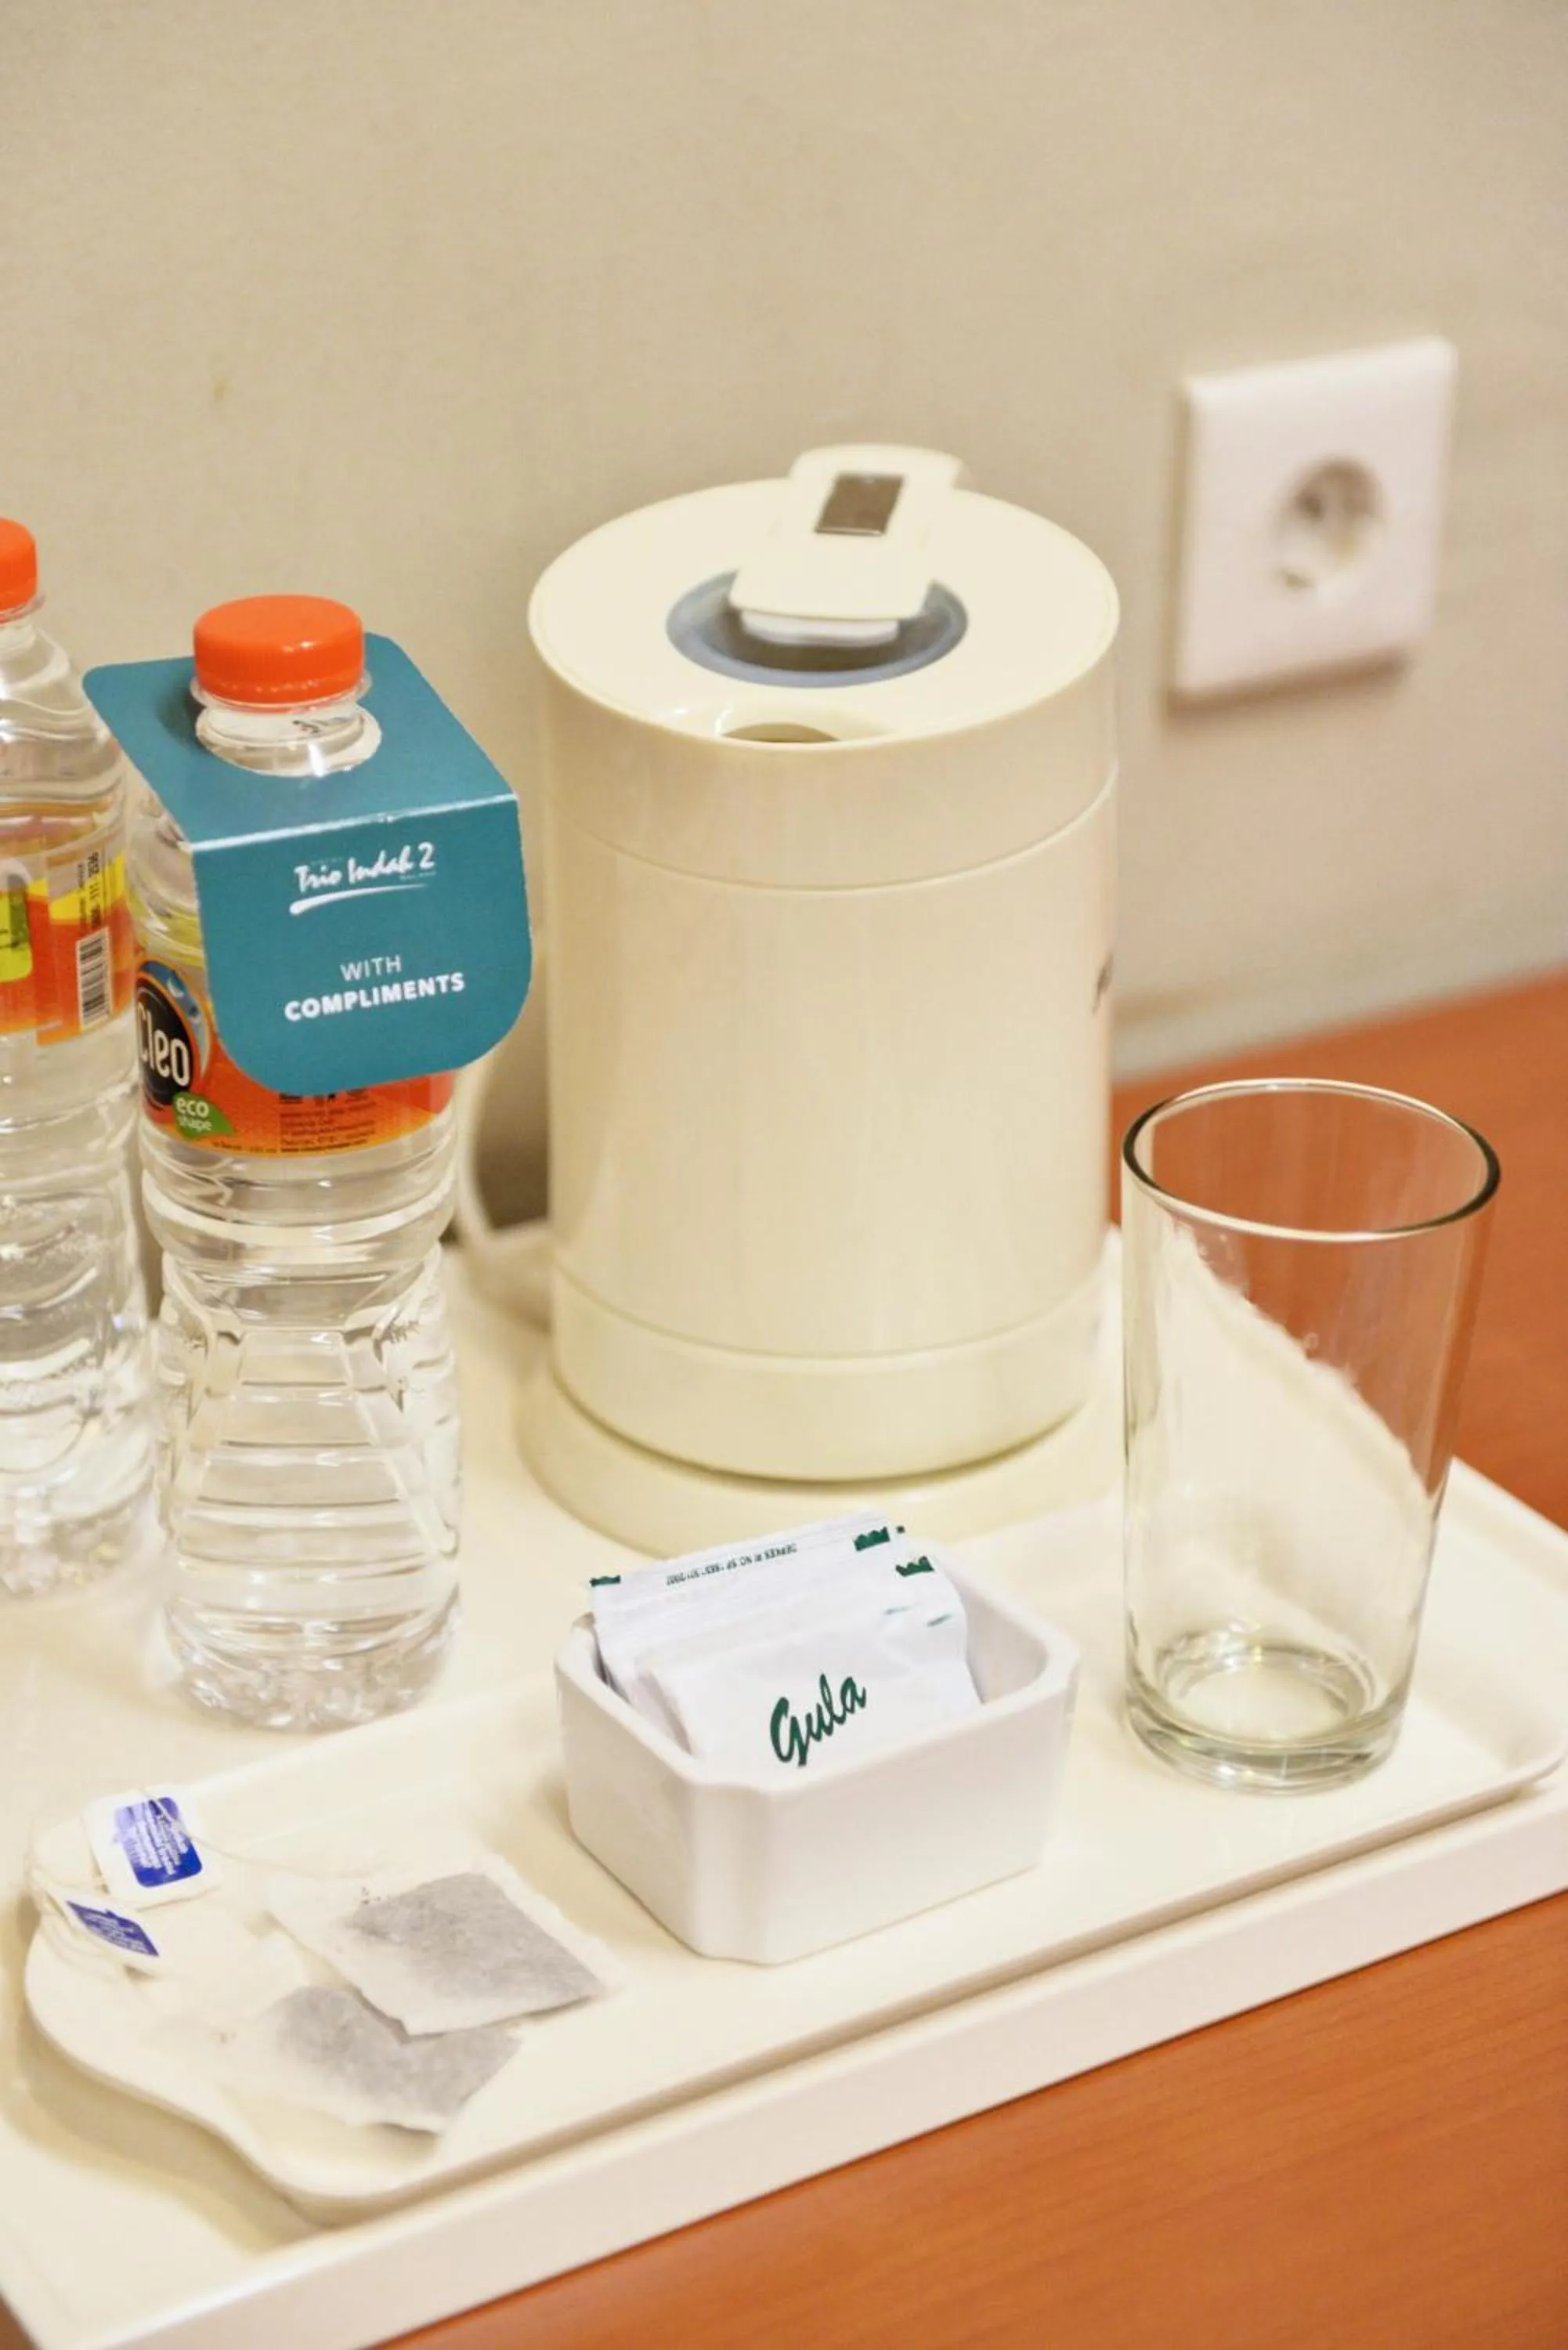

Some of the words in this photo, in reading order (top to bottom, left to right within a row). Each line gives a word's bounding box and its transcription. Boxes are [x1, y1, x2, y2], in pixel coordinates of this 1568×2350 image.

[294, 865, 342, 892] Trio
[348, 845, 414, 884] Indah
[418, 841, 435, 869] 2
[340, 954, 402, 982] WITH
[284, 972, 465, 1021] COMPLIMENTS
[137, 1002, 190, 1086] Cleo
[176, 1097, 209, 1118] eco
[177, 1114, 213, 1133] shape
[770, 1672, 866, 1768] Gula
